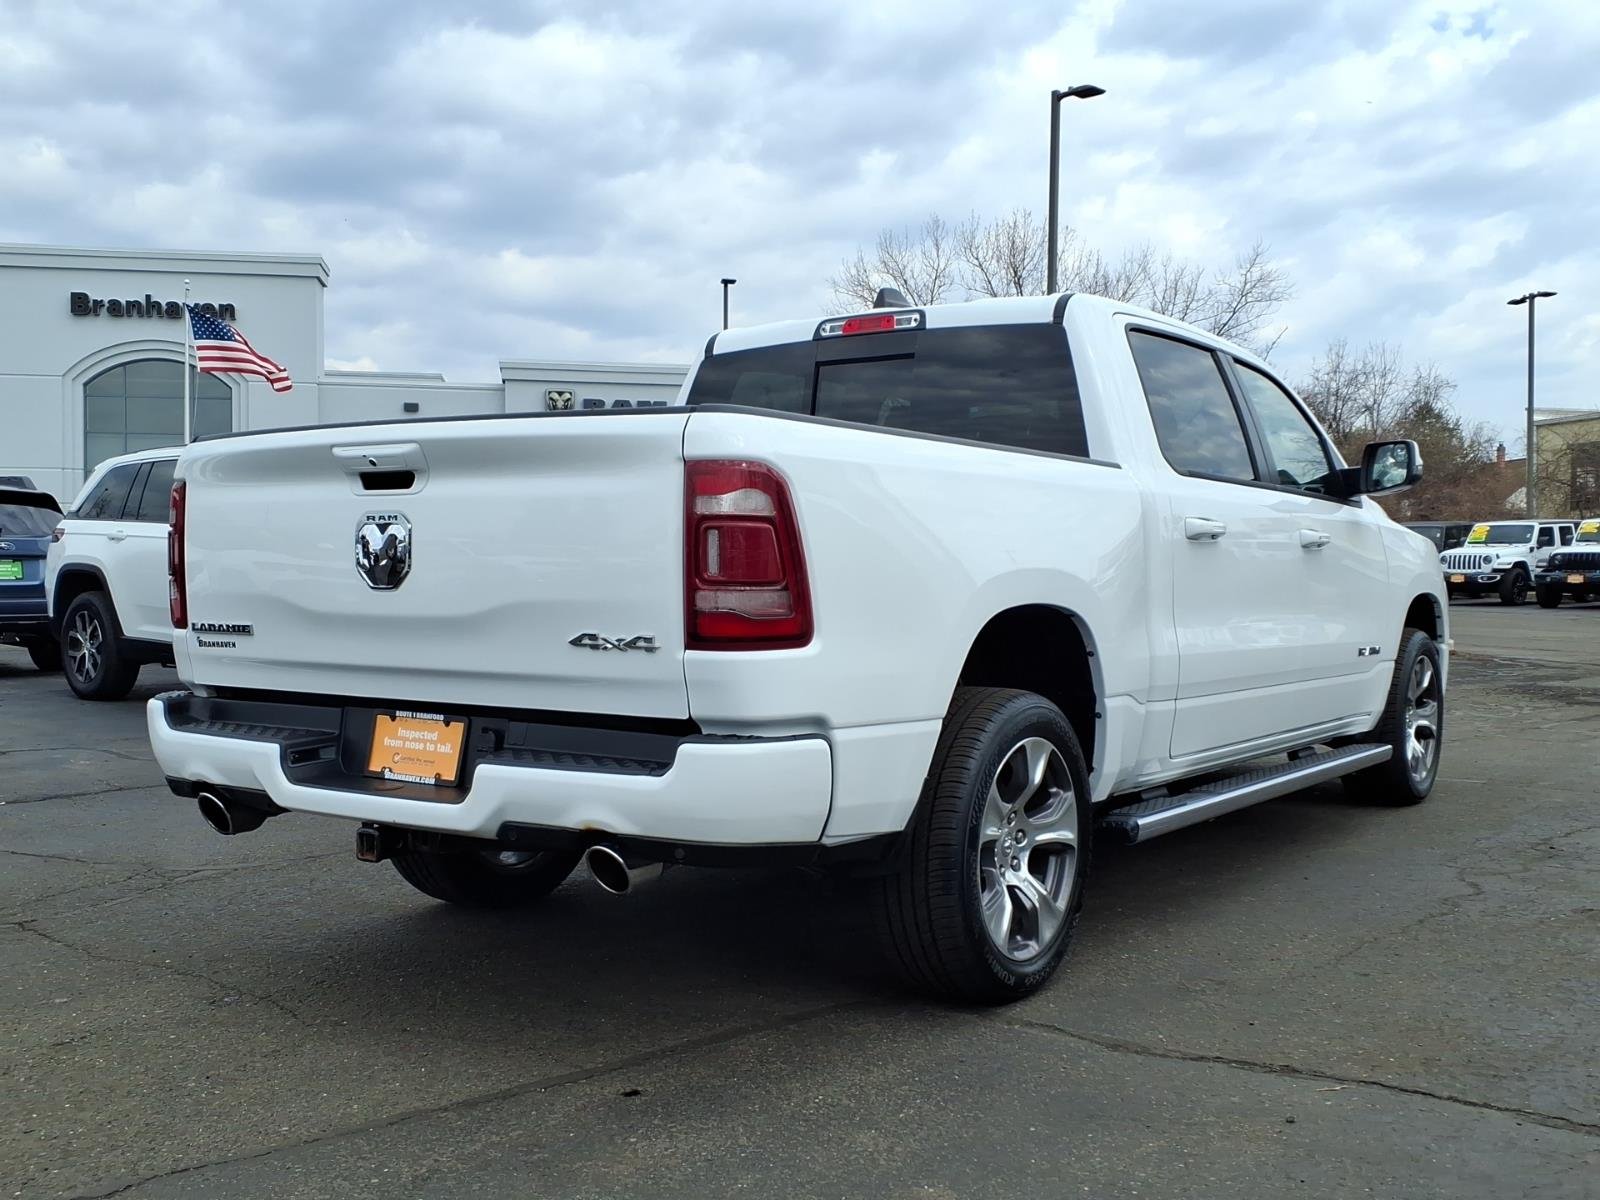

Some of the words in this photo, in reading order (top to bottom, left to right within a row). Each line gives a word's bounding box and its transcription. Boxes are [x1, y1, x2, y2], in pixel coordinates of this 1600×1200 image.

[191, 622, 254, 636] LARAMIE
[197, 638, 237, 649] BRANHAVEN
[397, 727, 439, 741] Inspected
[383, 736, 403, 748] from
[405, 740, 424, 751] nose
[426, 742, 435, 751] to
[437, 743, 453, 753] tail.
